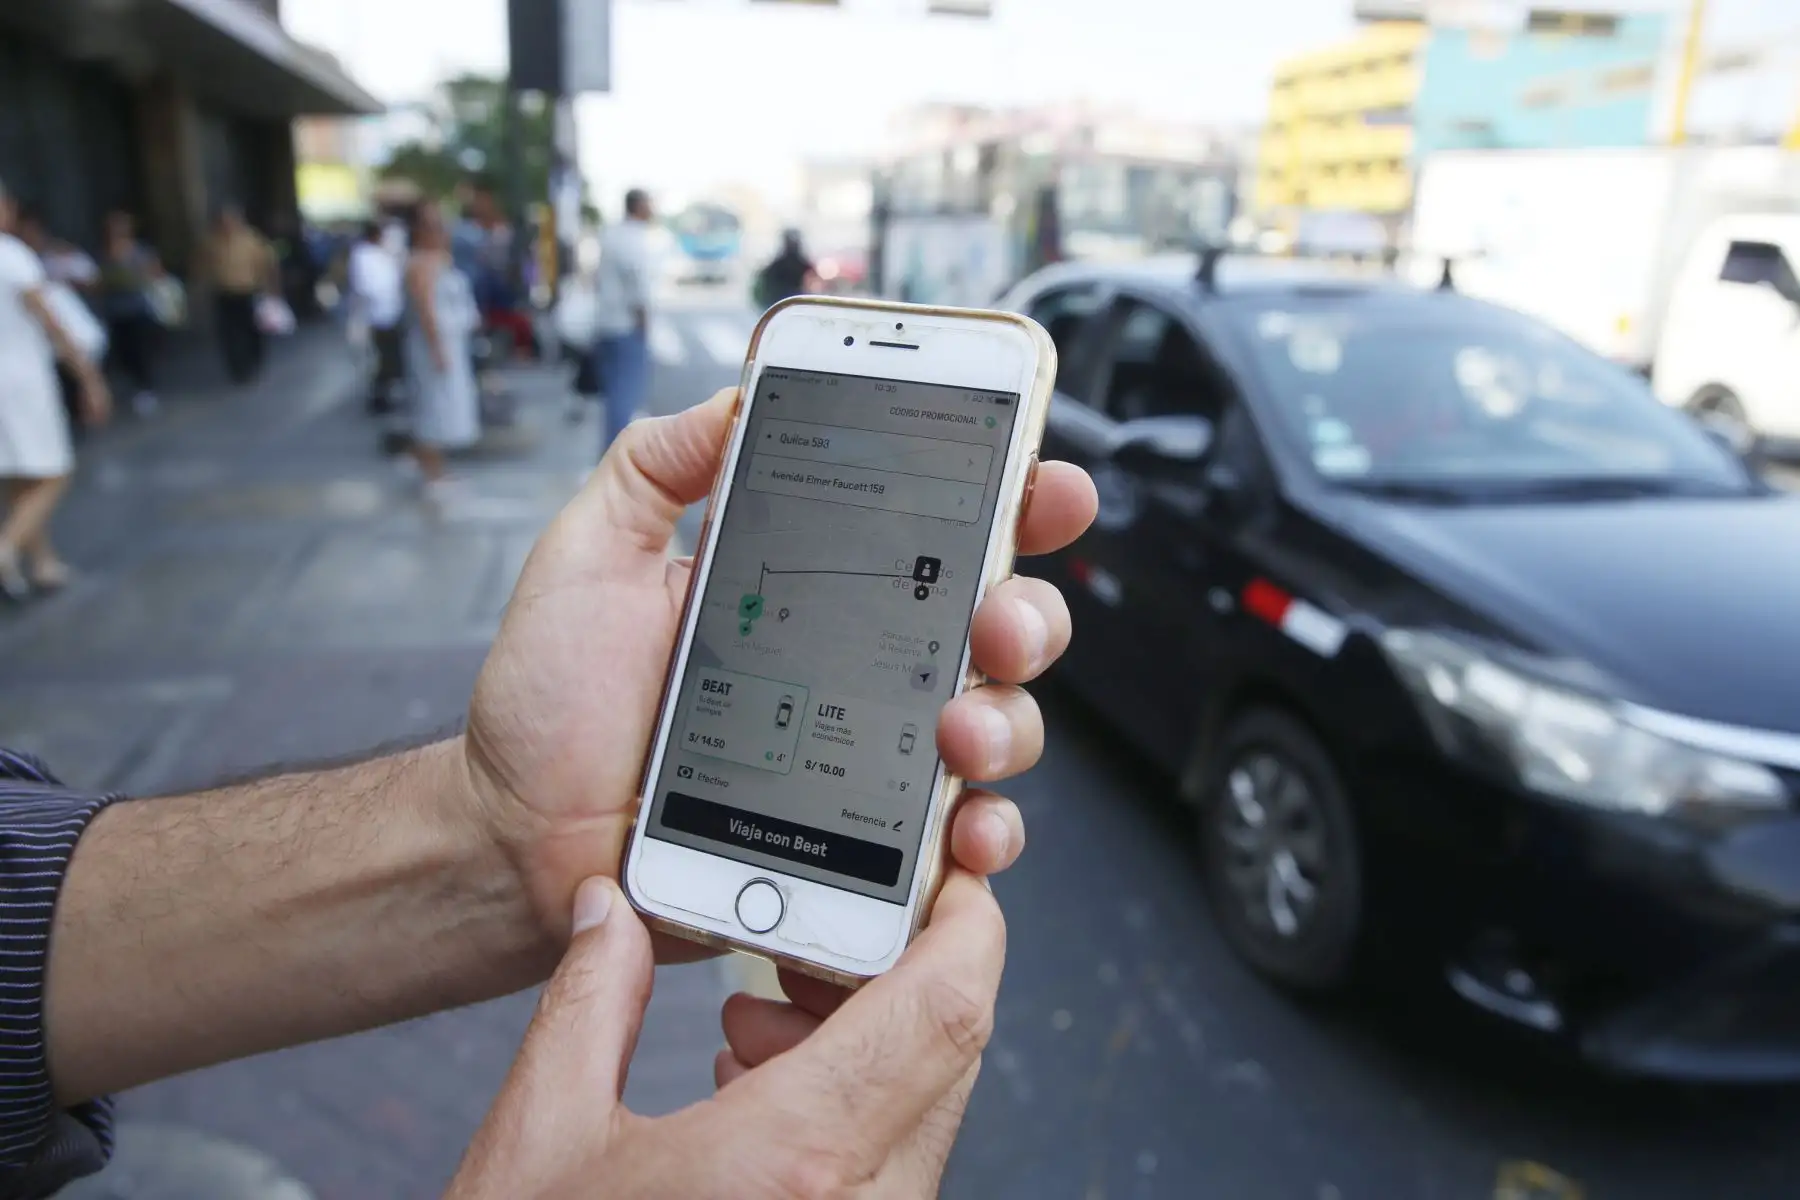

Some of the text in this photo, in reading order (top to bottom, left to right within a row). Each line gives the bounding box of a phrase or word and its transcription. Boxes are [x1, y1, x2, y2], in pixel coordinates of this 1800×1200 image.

[920, 410, 978, 426] PROMOCIONAL
[779, 432, 829, 450] Quilca 593
[770, 469, 885, 495] Avenida Elmer Faucett 159
[892, 577, 909, 590] de
[701, 679, 732, 696] BEAT
[818, 703, 846, 721] LITE
[701, 736, 726, 750] 14.50
[818, 763, 846, 778] 10.00
[697, 772, 729, 788] Efectivo
[841, 808, 886, 828] Referencia
[729, 818, 828, 857] Viaja con Beat
